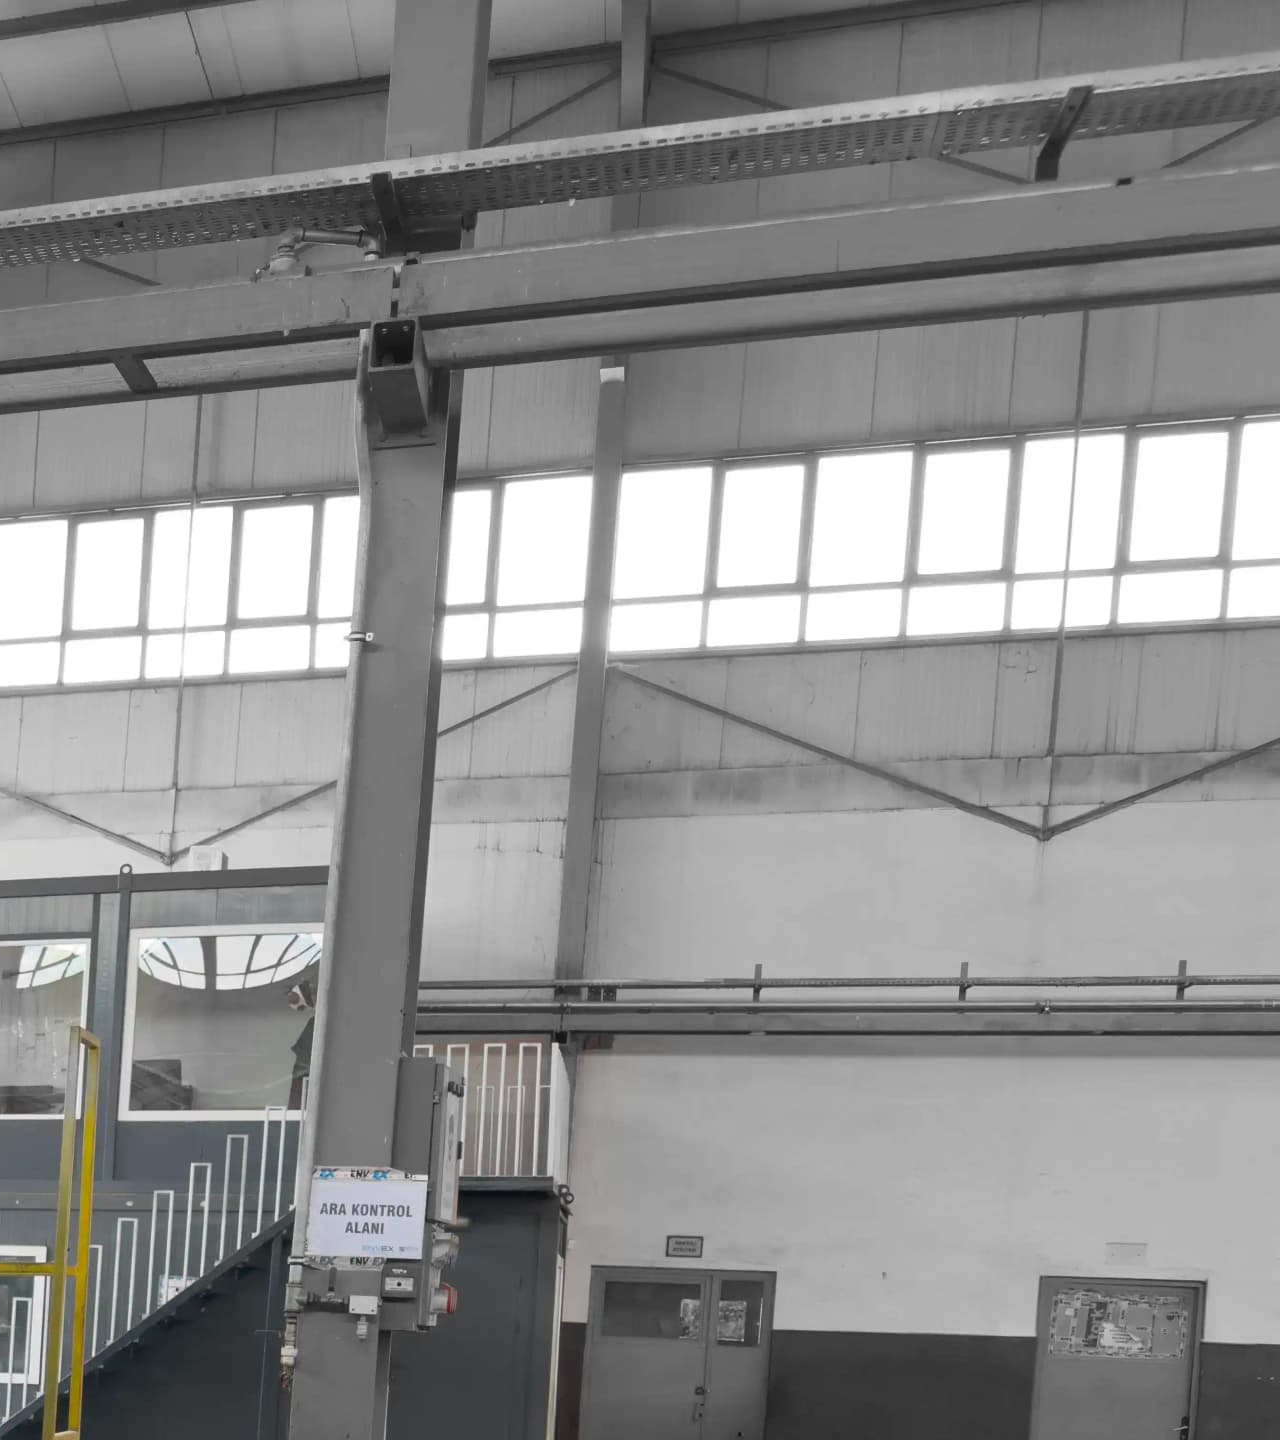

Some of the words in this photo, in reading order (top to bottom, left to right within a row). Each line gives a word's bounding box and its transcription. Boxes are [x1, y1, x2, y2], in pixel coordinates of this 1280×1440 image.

[319, 1202, 346, 1216] ARA
[351, 1203, 413, 1218] KONTROL
[345, 1221, 385, 1235] ALANI
